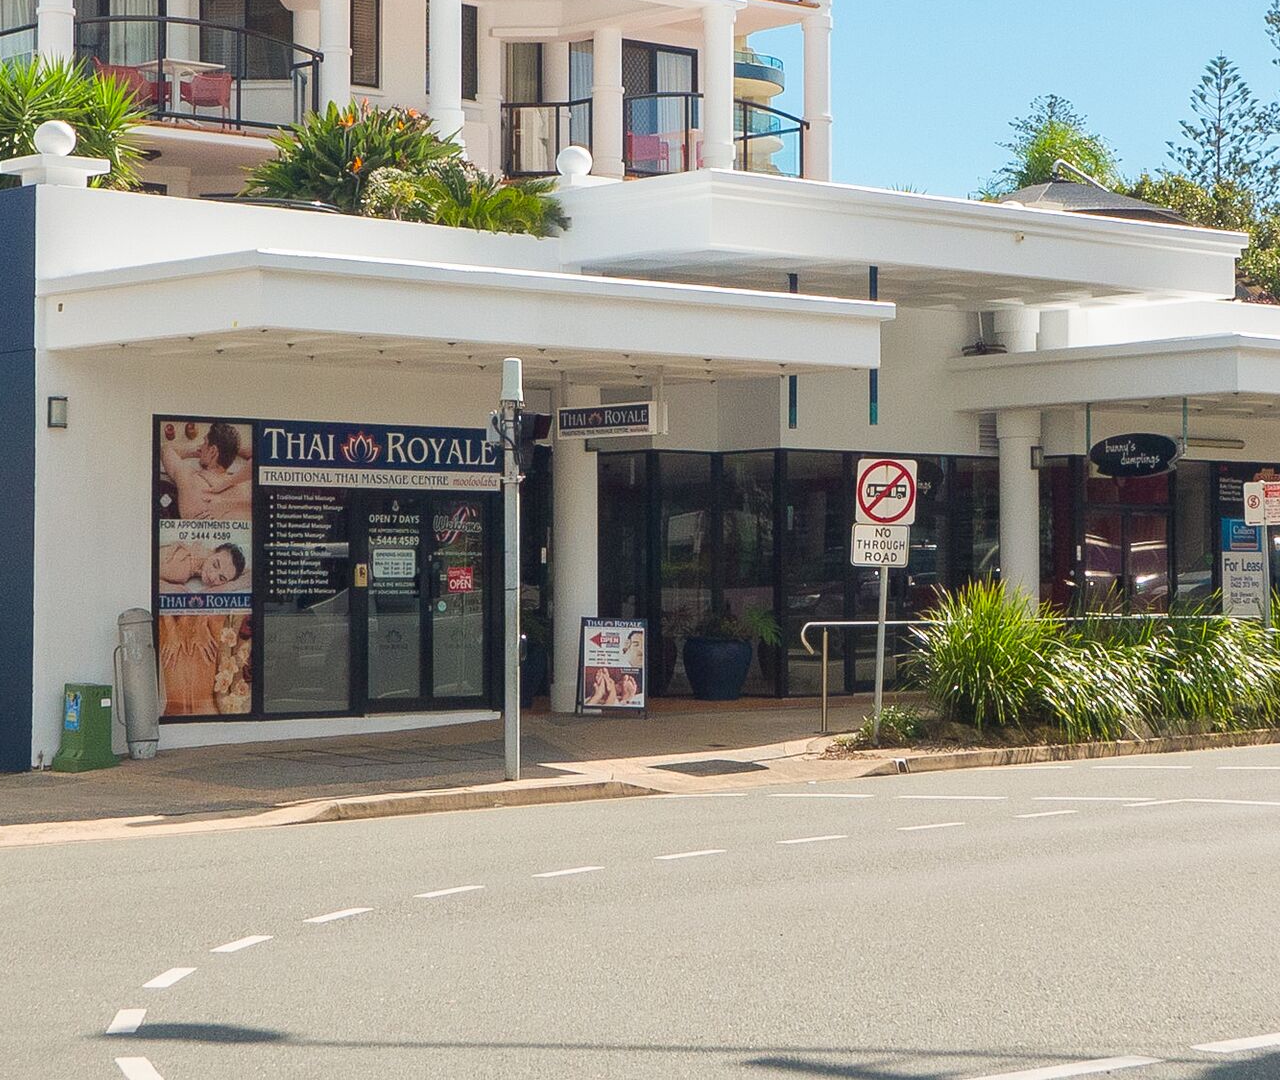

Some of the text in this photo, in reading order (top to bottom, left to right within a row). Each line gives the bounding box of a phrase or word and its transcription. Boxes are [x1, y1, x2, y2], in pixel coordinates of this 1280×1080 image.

[560, 409, 647, 426] THAI ROYALE
[264, 428, 497, 466] THAI ROYALE
[1105, 440, 1136, 455] bunny's
[1121, 452, 1160, 468] dumplings
[264, 471, 333, 483] TRADITIONAL
[335, 473, 359, 483] THAI
[362, 474, 409, 485] MASSAGE
[411, 475, 449, 486] CENTRE
[368, 514, 420, 524] OPEN 7 DAYS
[433, 514, 483, 533] Welcome
[160, 521, 249, 530] FOR APPOINTMENTS CALL
[191, 532, 210, 540] 5444
[212, 532, 231, 540] 4589
[875, 528, 891, 538] NO
[377, 536, 420, 545] 5444 4589
[857, 539, 905, 550] THROUGH
[864, 552, 897, 562] ROAD
[1224, 558, 1239, 572] For
[449, 579, 472, 590] OPEN
[160, 596, 251, 607] THAI ROYALE
